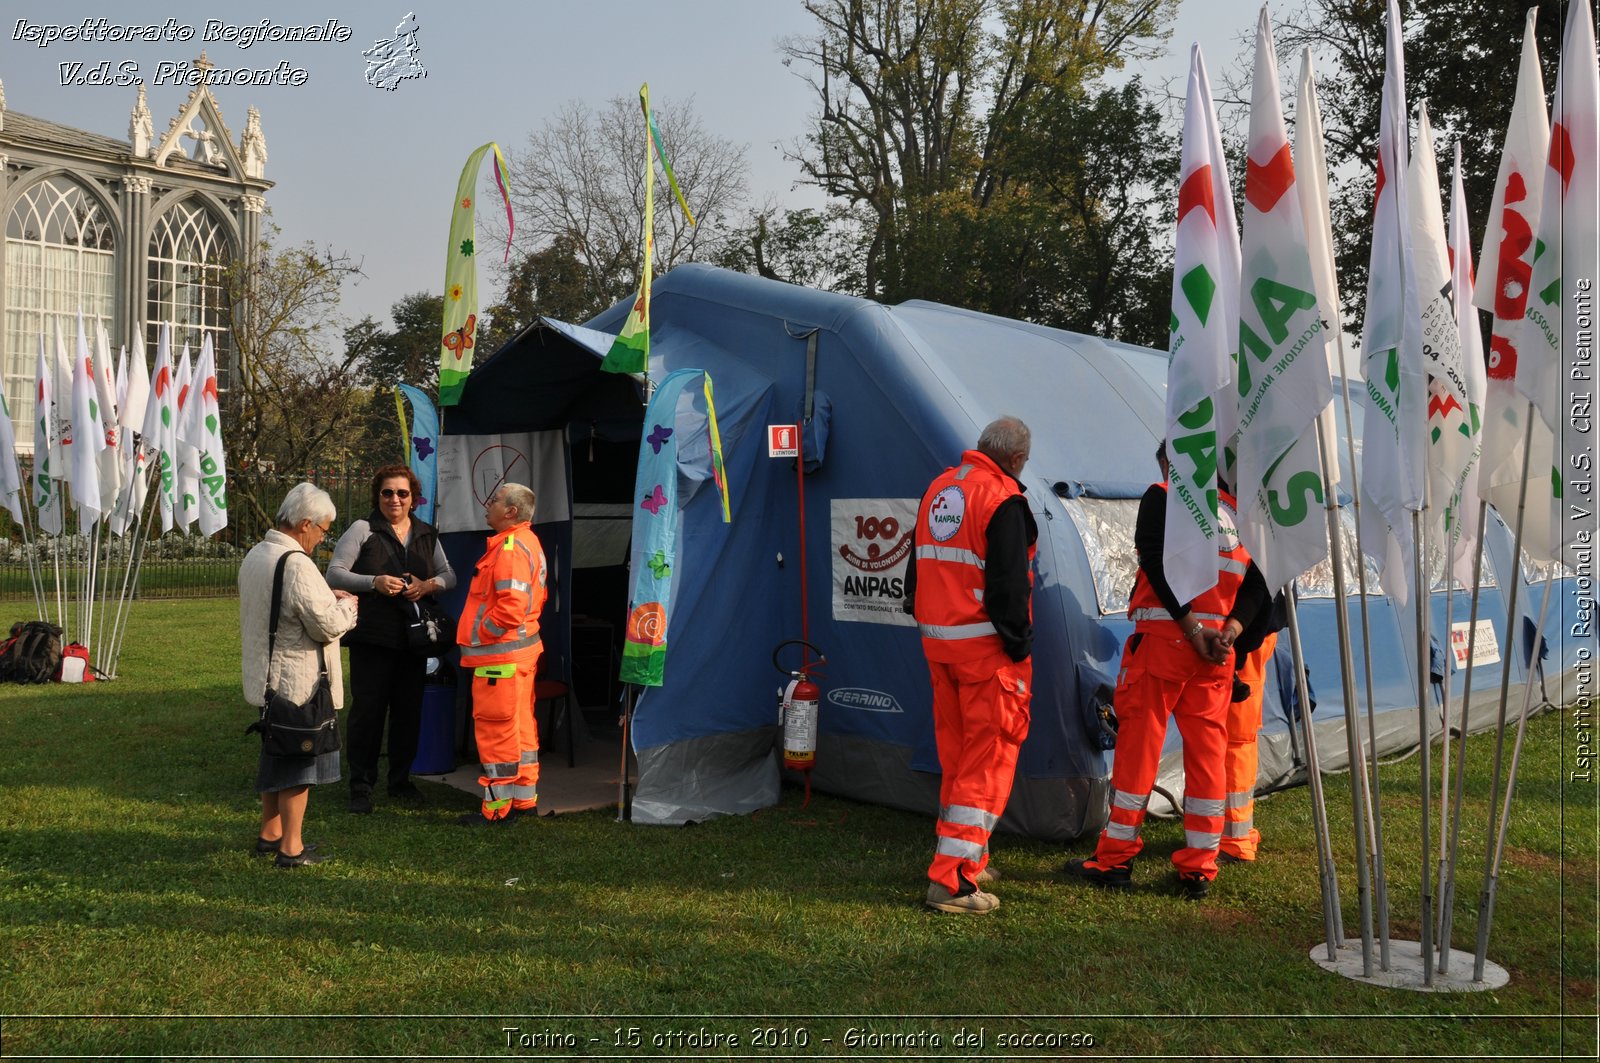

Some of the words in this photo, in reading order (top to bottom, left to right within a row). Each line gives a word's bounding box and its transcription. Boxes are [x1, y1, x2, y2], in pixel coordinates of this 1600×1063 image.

[1176, 484, 1215, 540] ASSISTENZE
[854, 515, 899, 541] 100
[869, 539, 912, 570] VOLONTARIATO
[843, 575, 904, 600] ANPAS
[844, 603, 867, 612] COMITATO
[867, 604, 893, 613] REGIONALE
[894, 606, 905, 614] PIE
[833, 691, 892, 708] FERRINO
